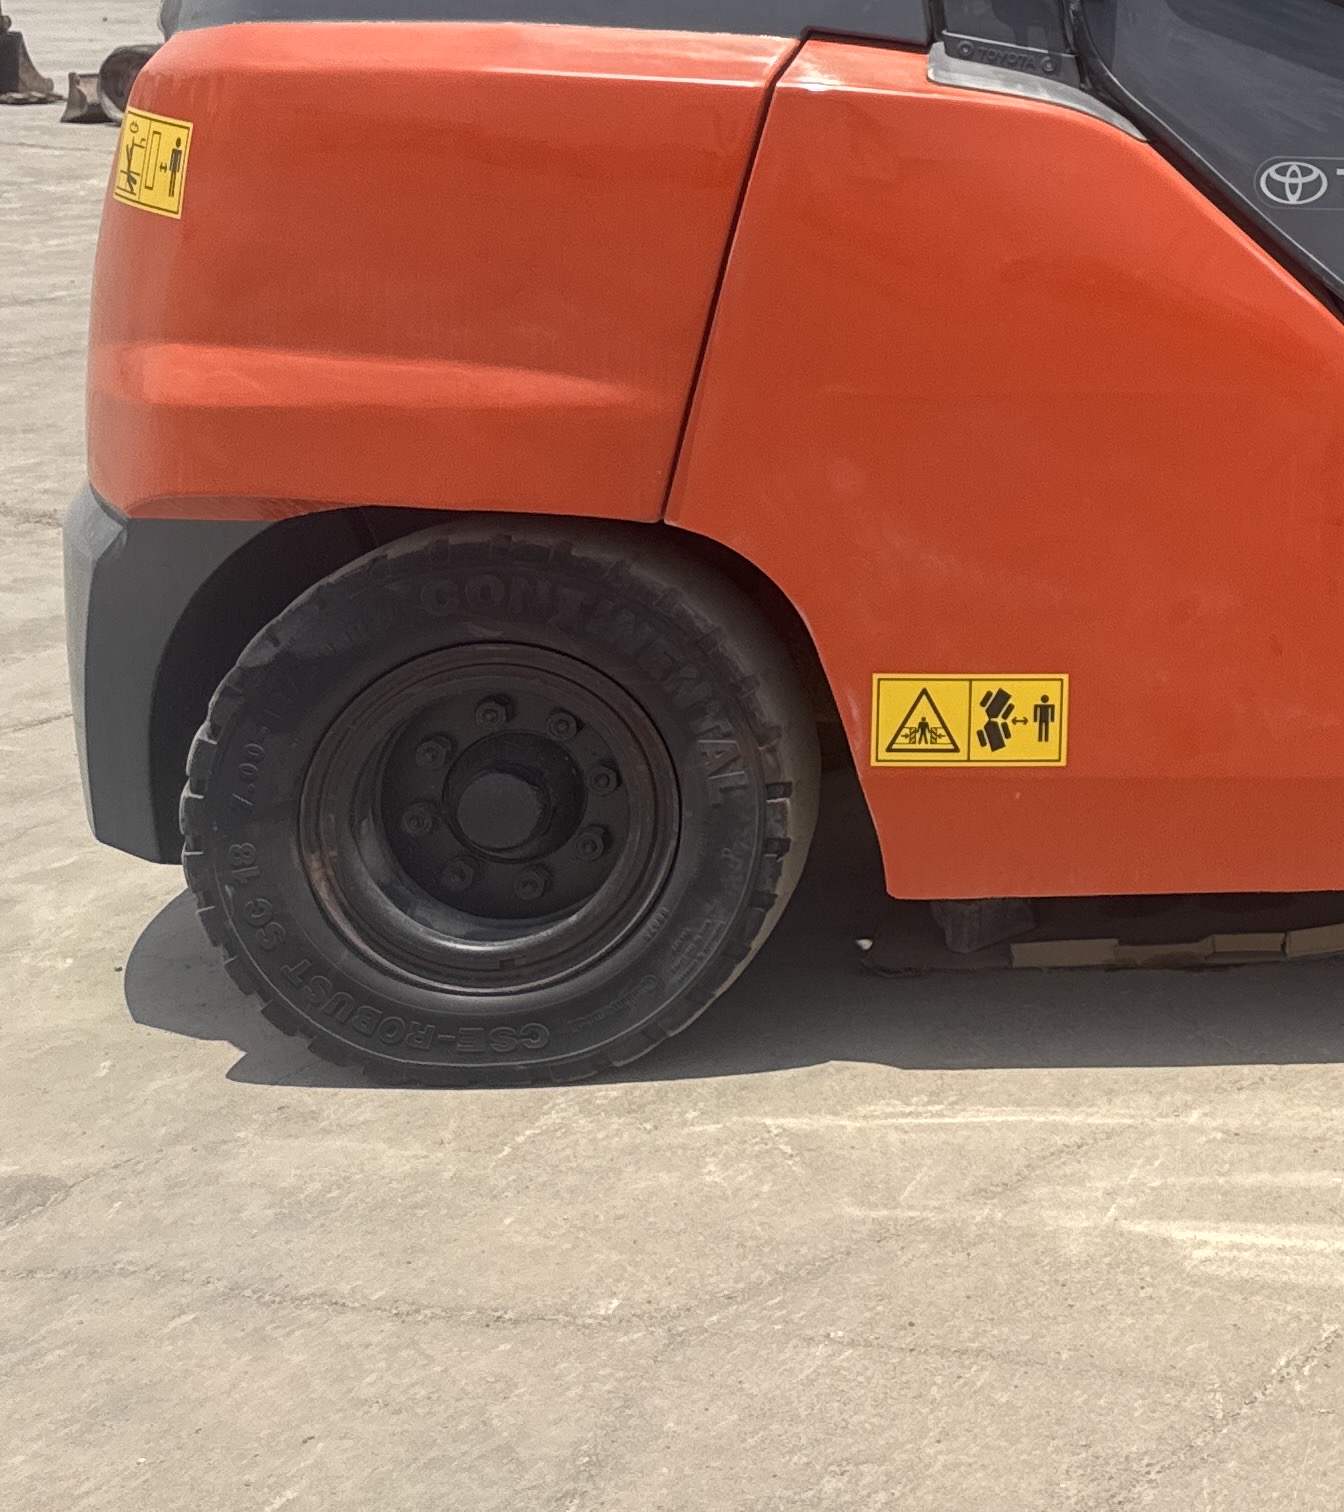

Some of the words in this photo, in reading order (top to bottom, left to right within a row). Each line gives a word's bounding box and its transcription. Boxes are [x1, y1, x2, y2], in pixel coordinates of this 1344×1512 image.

[228, 840, 260, 886] 18
[243, 896, 285, 950] SC
[281, 958, 551, 1053] CSE-ROBUST
